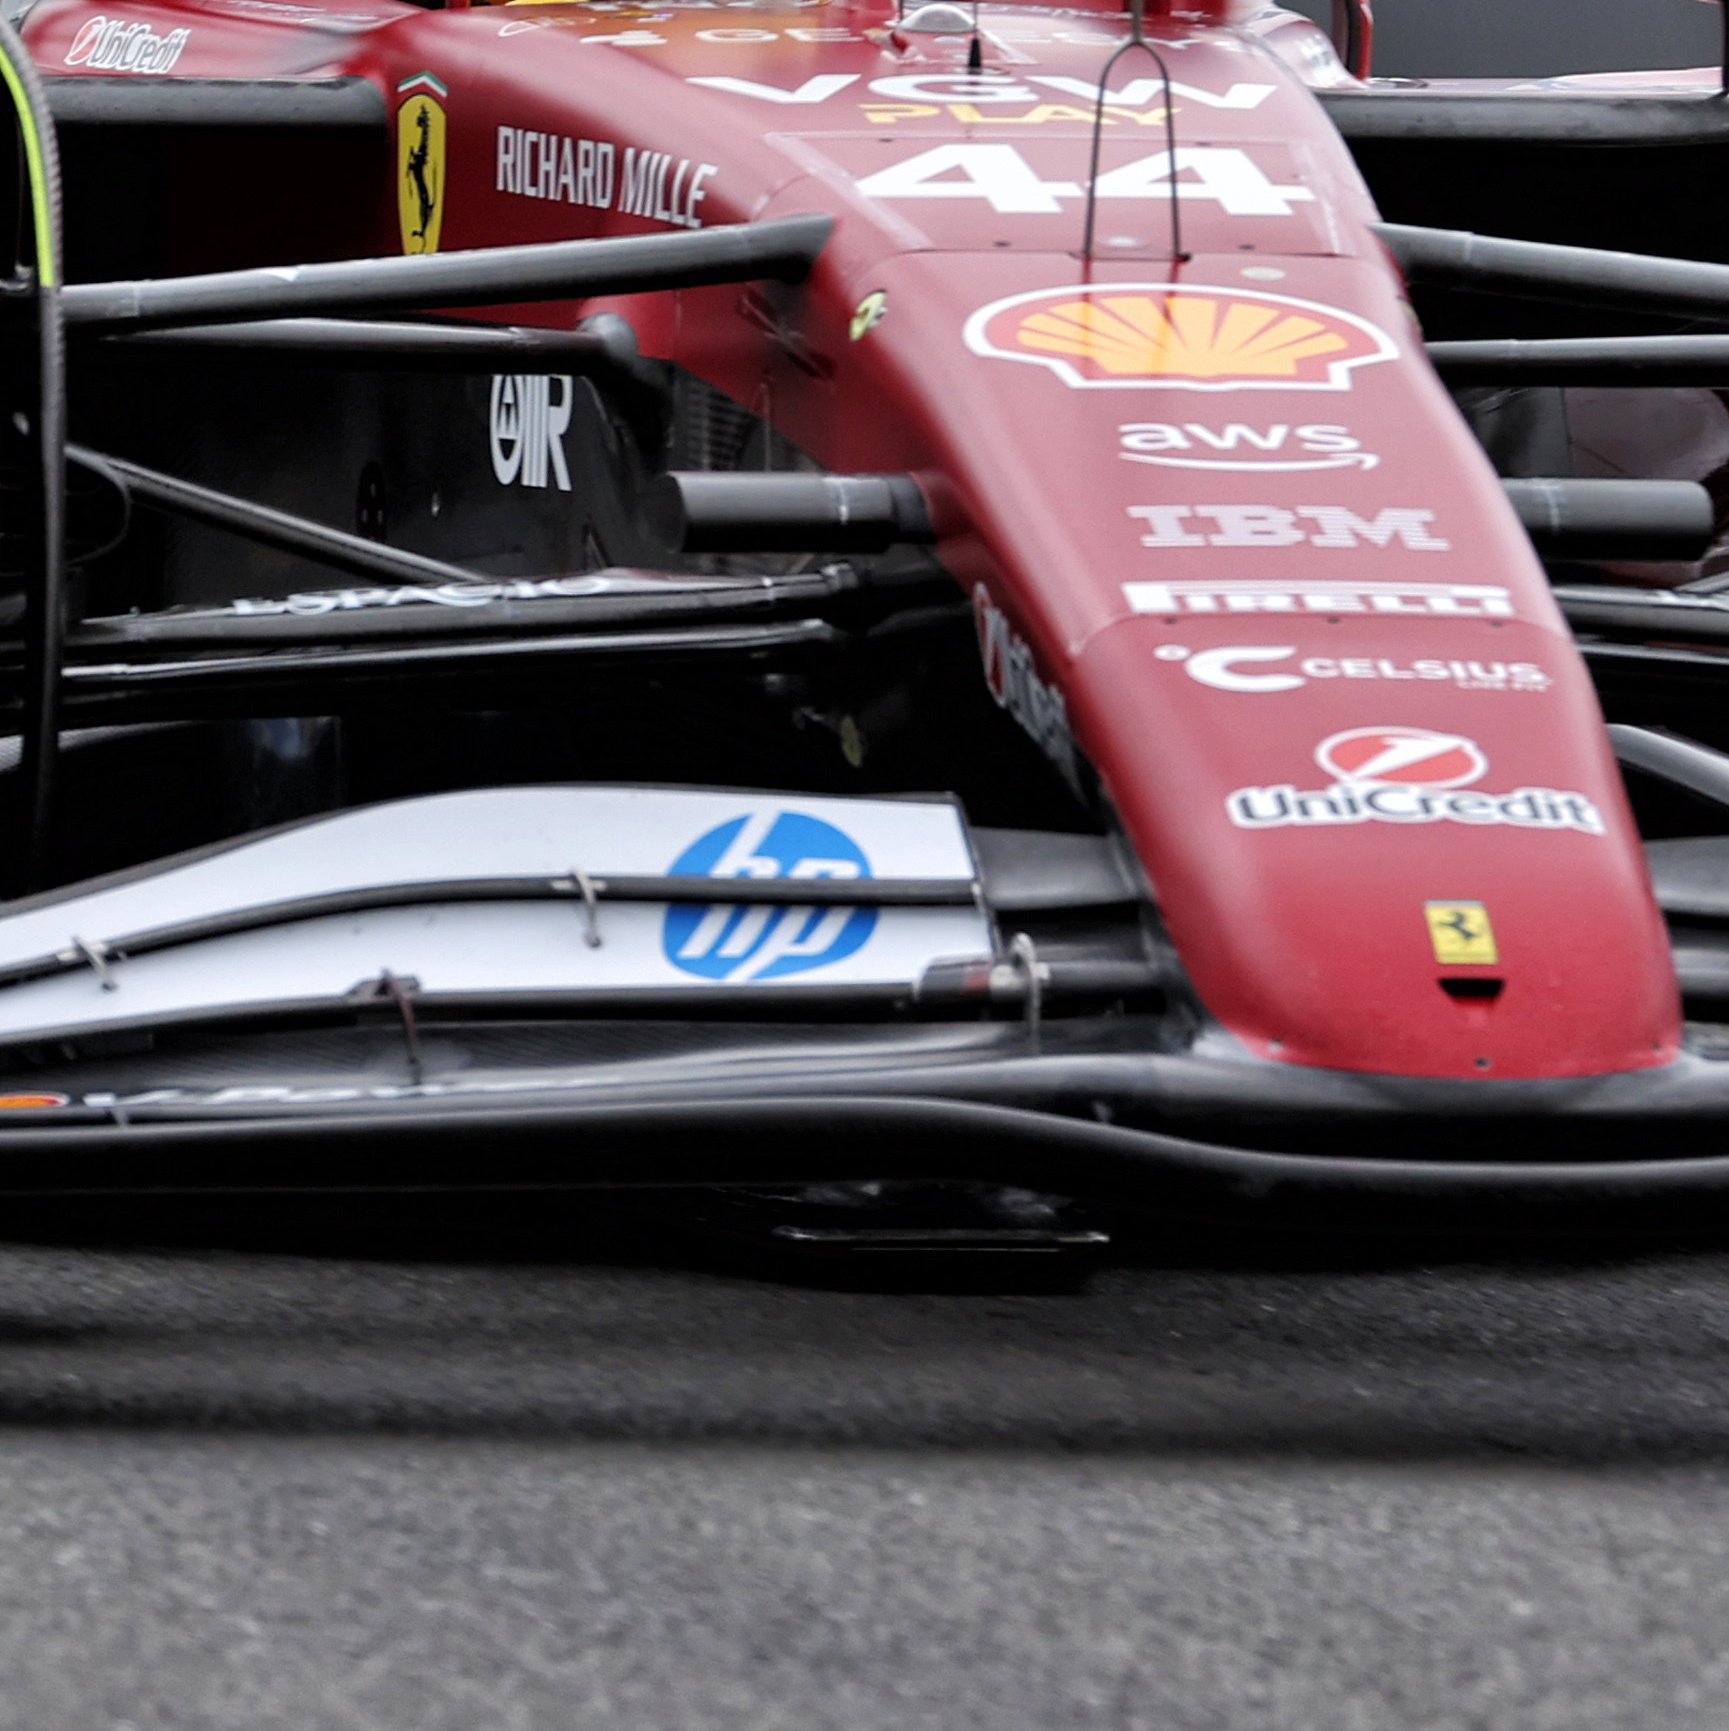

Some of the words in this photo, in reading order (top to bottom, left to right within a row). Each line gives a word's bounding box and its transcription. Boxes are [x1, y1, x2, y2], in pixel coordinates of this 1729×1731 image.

[686, 73, 1278, 109] VGW
[860, 103, 1182, 127] PLAY
[496, 125, 615, 210] RICHARD
[618, 146, 719, 229] MILLE
[853, 143, 1317, 215] 44
[1119, 422, 1362, 452] aws
[1127, 504, 1450, 551] IBM
[1122, 581, 1515, 616] PIRELLI
[1301, 656, 1544, 683] CELSIUS
[1232, 785, 1602, 834] UniCredit
[678, 812, 862, 981] hp
